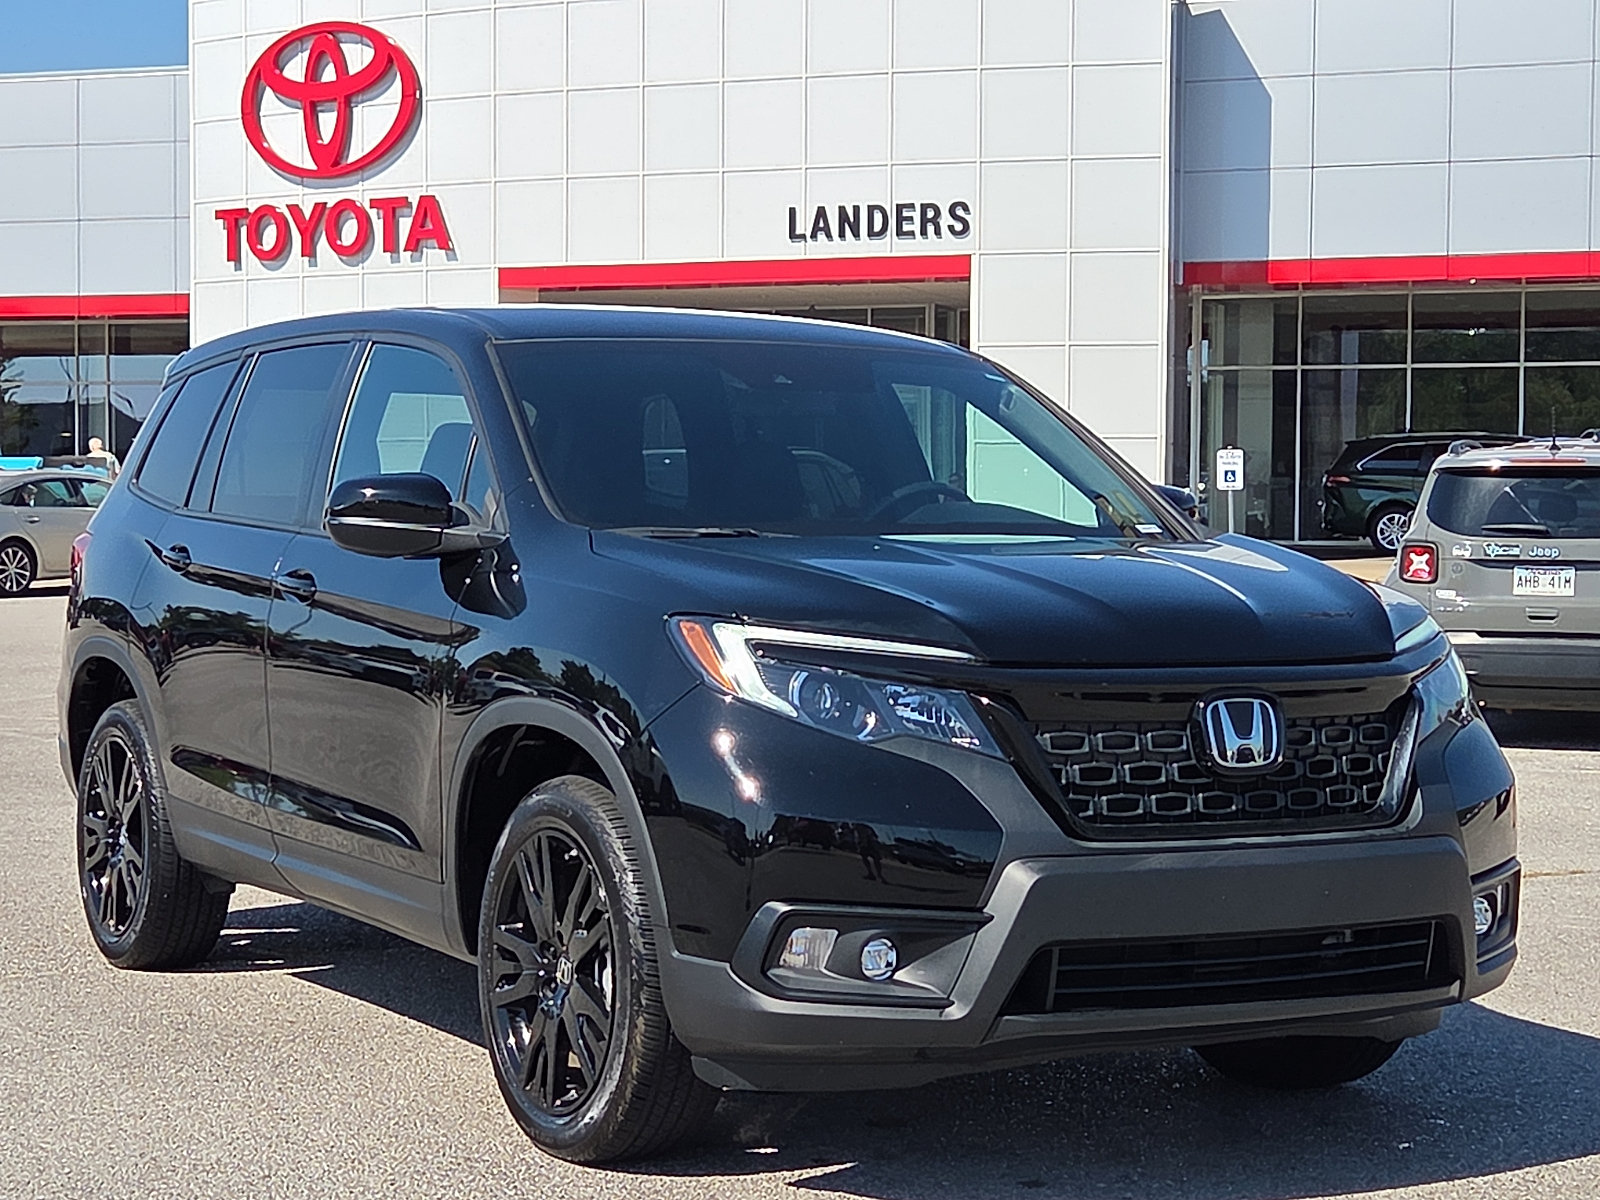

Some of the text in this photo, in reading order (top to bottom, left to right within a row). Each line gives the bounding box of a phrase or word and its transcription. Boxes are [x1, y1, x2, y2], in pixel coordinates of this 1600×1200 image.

[214, 194, 456, 264] TOYOTA
[788, 201, 972, 243] LANDERS
[1517, 576, 1540, 588] AHB
